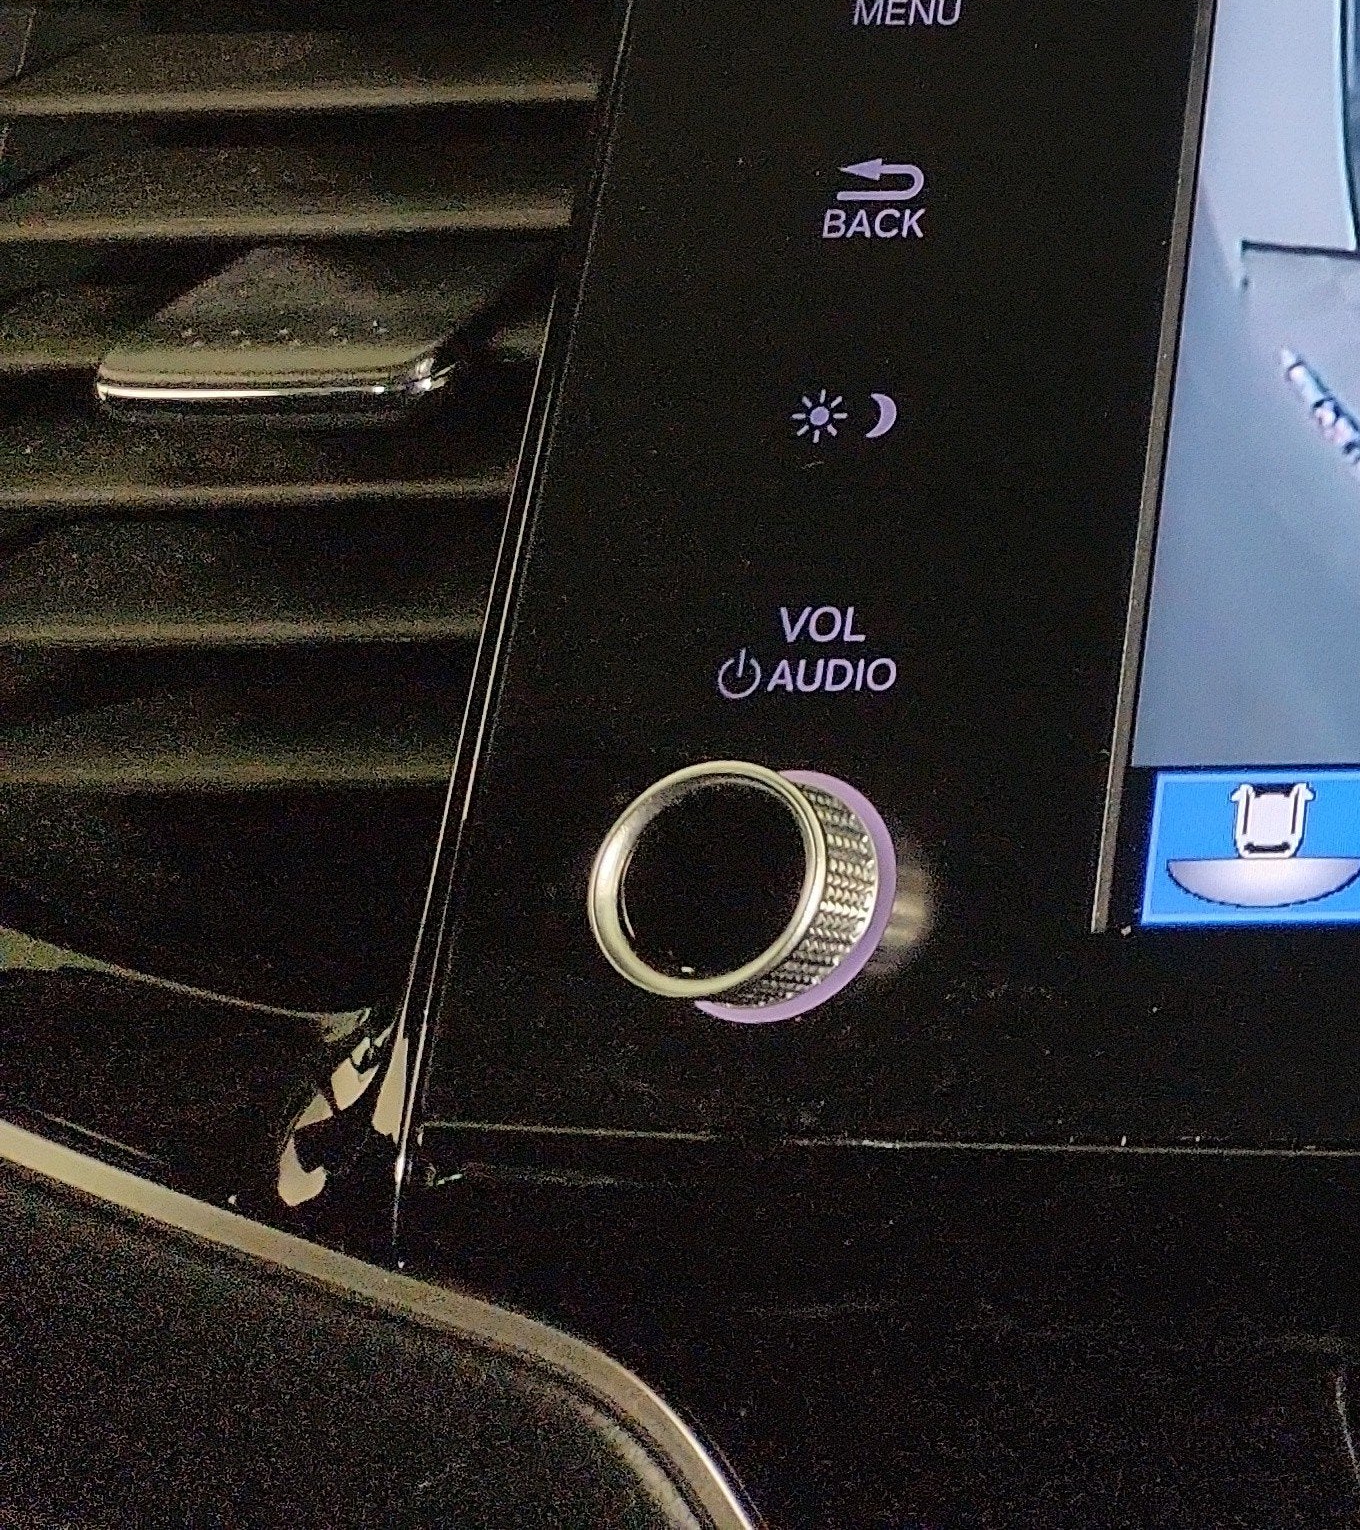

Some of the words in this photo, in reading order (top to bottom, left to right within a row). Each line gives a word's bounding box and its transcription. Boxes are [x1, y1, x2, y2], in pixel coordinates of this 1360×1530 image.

[821, 207, 927, 239] BACK
[779, 605, 868, 643] VOL
[765, 657, 898, 693] AUDIO
